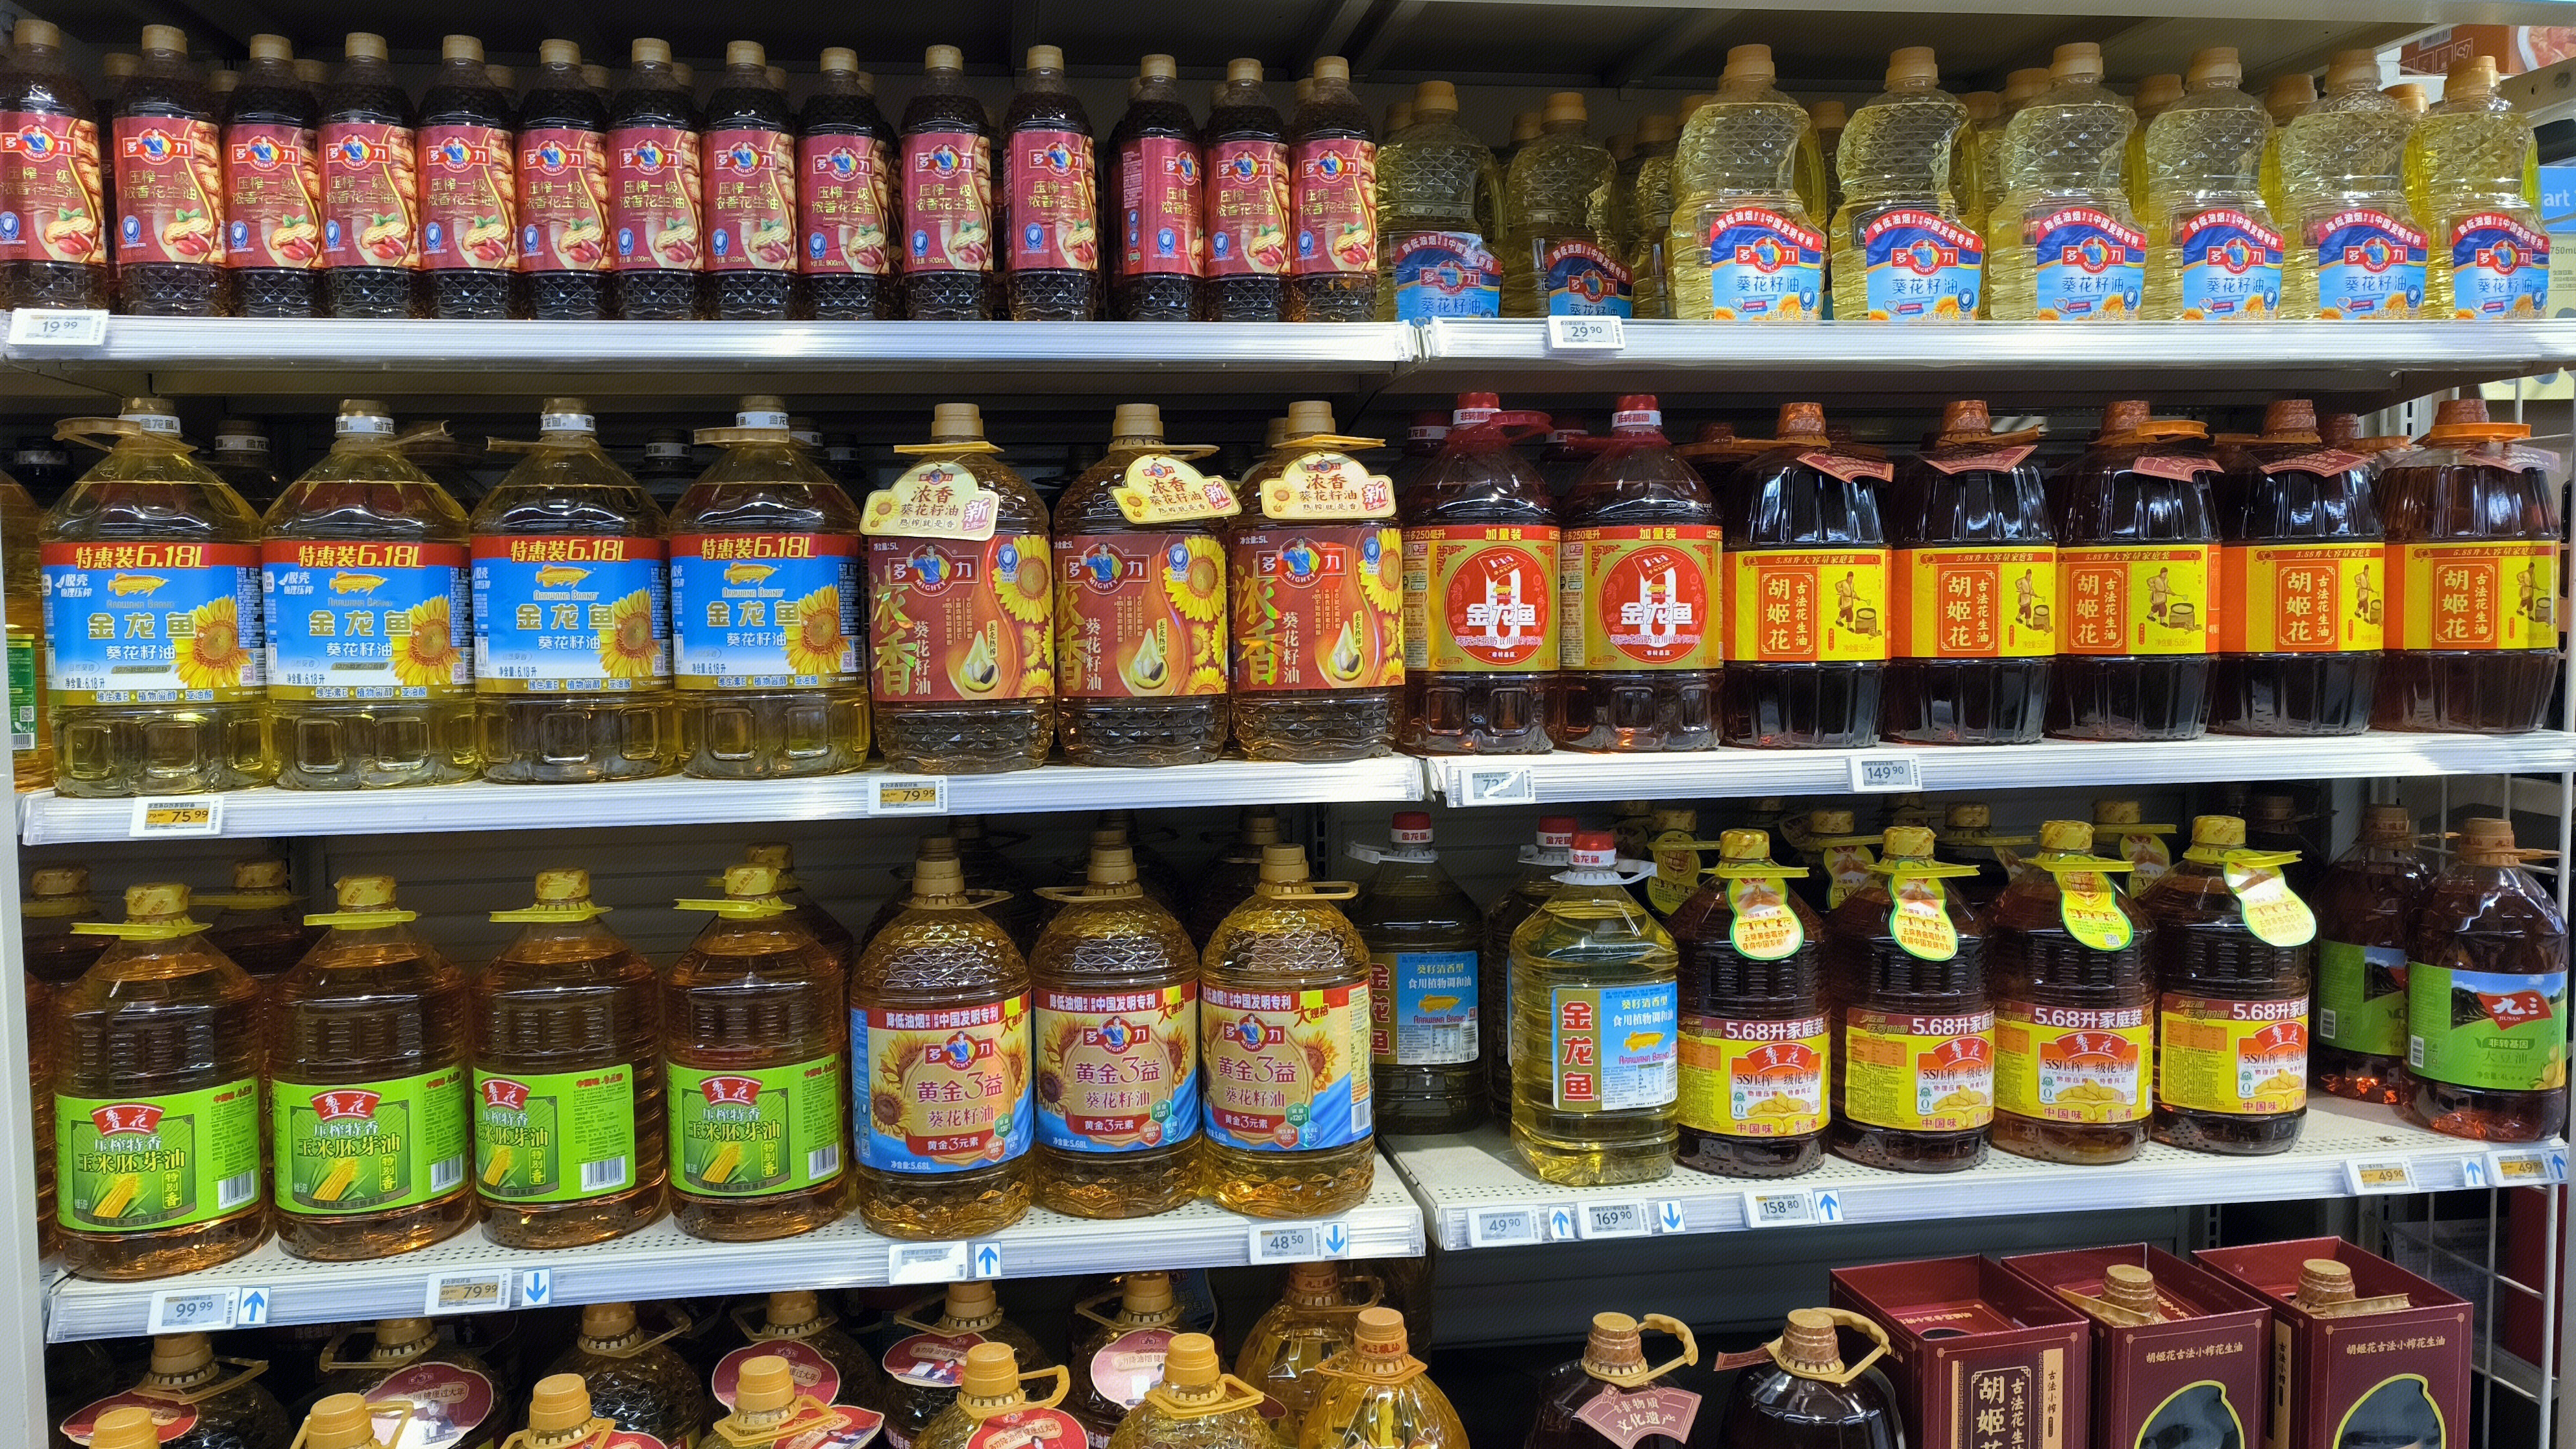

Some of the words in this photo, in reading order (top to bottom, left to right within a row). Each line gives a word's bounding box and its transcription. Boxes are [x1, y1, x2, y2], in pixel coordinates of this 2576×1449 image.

[8, 168, 72, 182] 压榨一级
[129, 170, 190, 186] 压榨一级
[330, 175, 387, 190] 压榨一级
[0, 182, 80, 199] 浓香花生油
[123, 184, 198, 201] 浓香花生油
[236, 177, 296, 192] 压榨一级
[431, 178, 487, 193] 压榨一级
[528, 181, 582, 195] 压榨一级
[624, 180, 678, 195] 压榨一级
[718, 181, 773, 196] 压榨一级
[817, 186, 870, 201] 压榨一级
[231, 191, 306, 207] 浓香花生油
[326, 190, 395, 204] 浓香花生油
[427, 193, 495, 207] 浓香花生油
[523, 195, 591, 210] 浓香花生油
[619, 195, 686, 210] 浓香花生油
[716, 195, 780, 210] 浓香花生油
[811, 201, 876, 215] 浓香花生油
[1737, 275, 1800, 292] 葵花籽油
[1892, 277, 1958, 295] 葵花籽油
[2062, 276, 2124, 293] 葵花籽油
[2207, 277, 2264, 293] 葵花籽油
[2345, 275, 2407, 293] 葵花籽油
[1421, 297, 1481, 315] 葵花籽油
[1148, 477, 1187, 494] 浓香
[1306, 474, 1348, 490] 浓香
[911, 486, 954, 503] 浓香
[1204, 482, 1227, 503] 新
[1363, 482, 1385, 504] 新
[963, 498, 991, 523] 新
[1485, 528, 1522, 541] 加量装
[1639, 528, 1677, 541] 加量装
[75, 546, 211, 569] 特惠装6.18L
[298, 545, 427, 569] 特惠装6.18L
[511, 539, 631, 562] 特惠装6.18L
[701, 536, 818, 562] 特惠装6.18L
[893, 562, 972, 580] 多力
[1069, 561, 1143, 577] 多力
[1261, 555, 1340, 571] 多力
[915, 578, 947, 591] MIGHTY
[1088, 576, 1118, 590] MIGHTY
[1285, 570, 1316, 583] MIGHTY
[533, 589, 570, 601] ARAWANA
[723, 587, 758, 598] ARAWANA
[1795, 580, 1808, 647] 古法花生油
[1947, 576, 1972, 649] 胡姬花
[1975, 578, 1990, 644] 古法花生油
[2076, 574, 2100, 645] 胡姬花
[2103, 578, 2117, 641] 古法花生油
[2286, 571, 2312, 643] 胡姬花
[2316, 575, 2330, 639] 古法花生油
[2441, 570, 2470, 640] 胡姬花
[2473, 573, 2488, 636] 古法花生油
[516, 604, 615, 630] 金龙鱼
[706, 601, 802, 627] 金龙鱼
[1465, 603, 1537, 626] 金龙鱼
[1620, 602, 1692, 626] 金龙鱼
[1766, 577, 1790, 651] 胡姬花
[88, 612, 197, 639] 金龙鱼
[308, 610, 414, 638] 金龙鱼
[538, 636, 601, 650] 葵花籽油
[726, 631, 787, 647] 葵花籽油
[106, 645, 177, 661] 葵花籽油
[326, 642, 394, 658] 葵花籽油
[1096, 993, 1156, 1011] 中国发明专利
[1233, 993, 1291, 1011] 中国发明专利
[2492, 997, 2540, 1015] 九三
[939, 1006, 998, 1028] 中国发明专利
[1294, 1003, 1329, 1028] 大规格
[2035, 1007, 2143, 1029] 5.68升家庭装
[1726, 1017, 1824, 1040] 5.68升家庭装
[1561, 1001, 1594, 1101] 金龙鱼
[1950, 1040, 1980, 1058] 鲁花
[2073, 1034, 2114, 1052] 鲁花
[2488, 1038, 2529, 1050] 非转基因
[1763, 1046, 1801, 1065] 鲁花
[2484, 1051, 2527, 1063] 大豆油
[1075, 1057, 1160, 1085] 黄金3益
[1218, 1056, 1296, 1083] 黄金3益
[488, 1079, 519, 1104] 鲁花
[711, 1079, 748, 1099] 鲁花
[916, 1071, 1004, 1103] 黄金3益
[323, 1095, 375, 1116] 鲁花
[701, 1107, 762, 1122] 压榨特香
[2044, 1106, 2083, 1120] 中国味
[2243, 1101, 2277, 1111] 中国味
[103, 1108, 148, 1130] 鲁花
[482, 1109, 529, 1126] 压榨特香
[1084, 1119, 1134, 1132] 黄金3元素
[1225, 1116, 1268, 1129] 黄金3元素
[1922, 1118, 1957, 1128] 中国味
[314, 1121, 380, 1139] 压榨特香
[475, 1122, 549, 1147] 玉米胚芽油
[687, 1121, 782, 1141] 玉米胚芽油
[1736, 1123, 1773, 1134] 中国味
[94, 1136, 163, 1153] 压榨特香
[297, 1133, 401, 1159] 玉米胚芽油
[928, 1136, 979, 1151] 黄金3元素
[78, 1149, 186, 1174] 玉米胚芽油
[530, 1150, 544, 1183] 特别香
[762, 1143, 776, 1176] 特别香
[380, 1155, 397, 1191] 特别香
[164, 1173, 179, 1208] 特别香
[2146, 1341, 2244, 1364] 胡姬花古法小榨花生油
[2346, 1335, 2446, 1355] 胡姬花古法小榨花生油
[1616, 1411, 1676, 1436] 文化遗产
